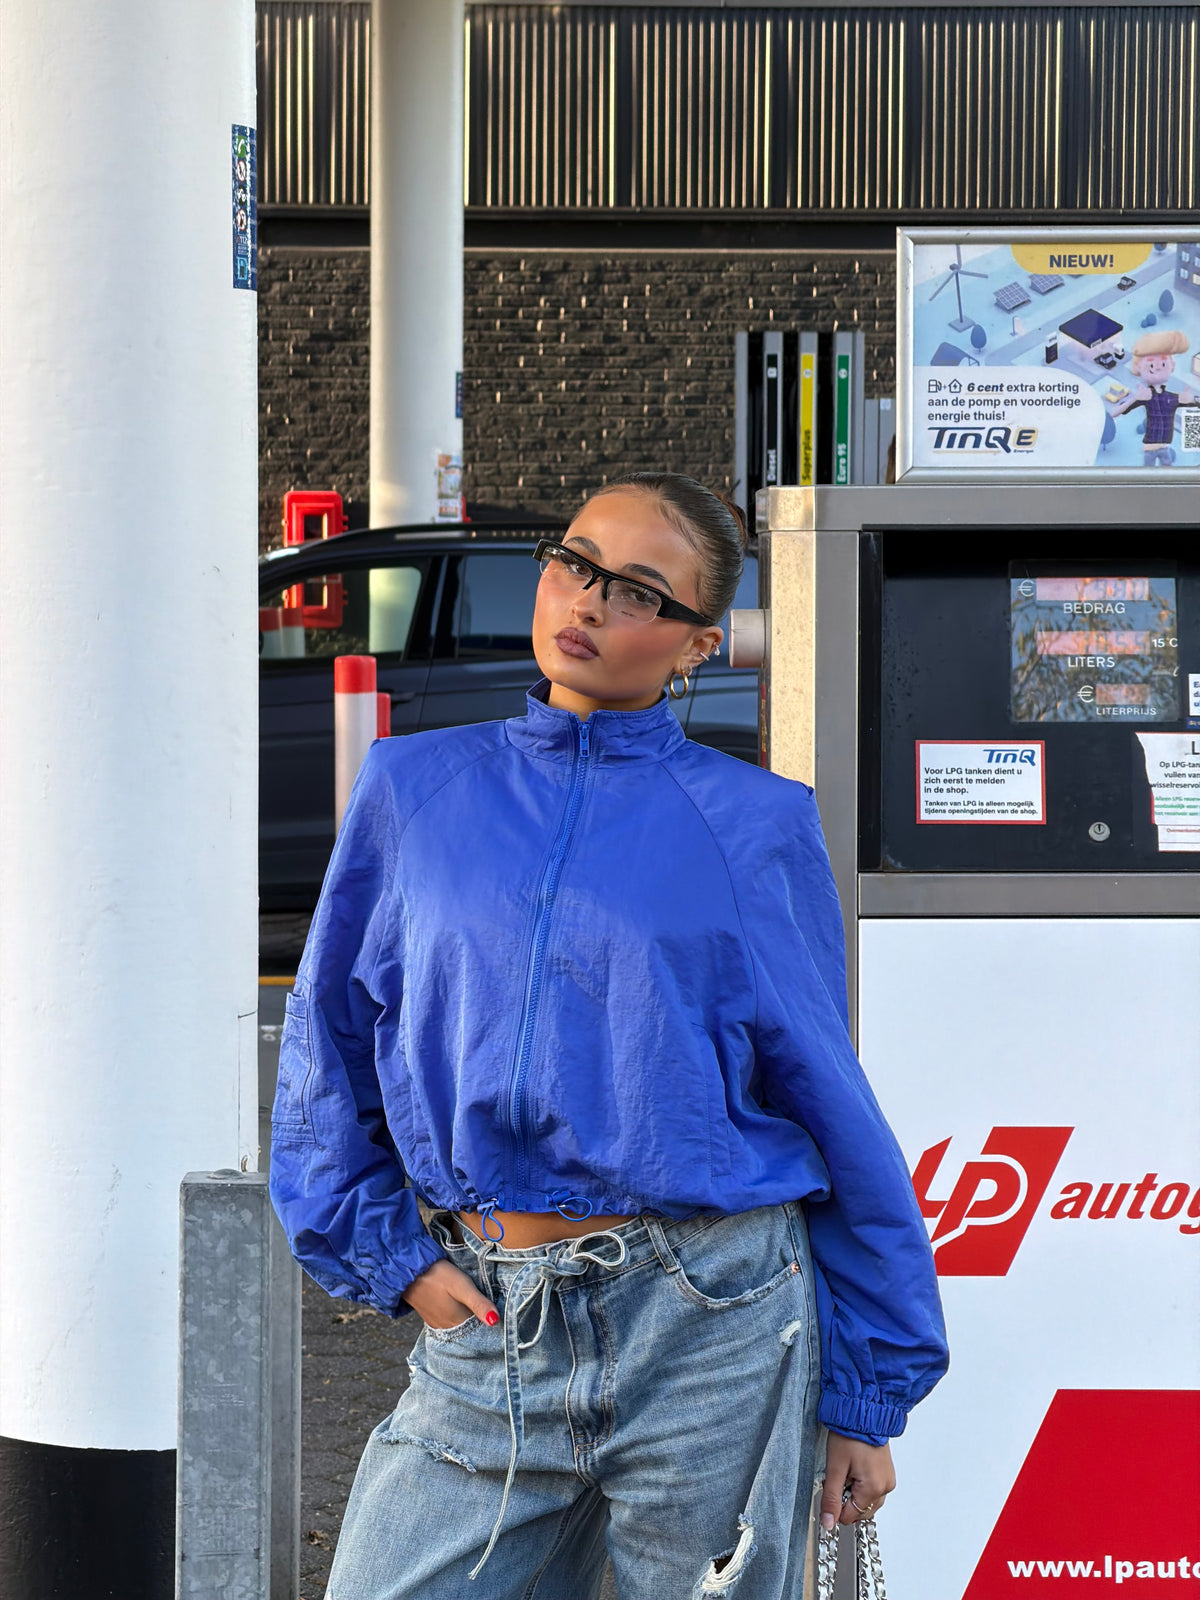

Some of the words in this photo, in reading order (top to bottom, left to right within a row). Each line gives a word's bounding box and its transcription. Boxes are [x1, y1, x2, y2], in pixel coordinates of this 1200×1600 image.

[1049, 254, 1114, 268] NIEUW!
[967, 382, 975, 393] 6
[977, 383, 1004, 393] cent
[1006, 383, 1036, 393] extra
[1038, 382, 1080, 395] korting
[928, 398, 949, 407] aan
[951, 396, 966, 407] de
[968, 398, 1001, 409] pomp
[1003, 398, 1018, 407] en
[1020, 396, 1081, 409] voordelige
[928, 411, 971, 423] energie
[973, 410, 1006, 421] thuis!
[837, 443, 847, 456] 95
[837, 457, 846, 482] Euro
[1063, 602, 1126, 614] BEDRAG
[1067, 656, 1116, 668] LITERS
[1096, 707, 1157, 716] LITERPRIJS
[924, 767, 943, 775] Voor
[945, 767, 963, 775] LPG
[965, 767, 992, 775] tanken
[994, 767, 1015, 775] dient
[1159, 761, 1170, 769] Op
[946, 786, 969, 795] shop.
[1007, 800, 1034, 808] mogelijk
[1020, 808, 1038, 816] shop.
